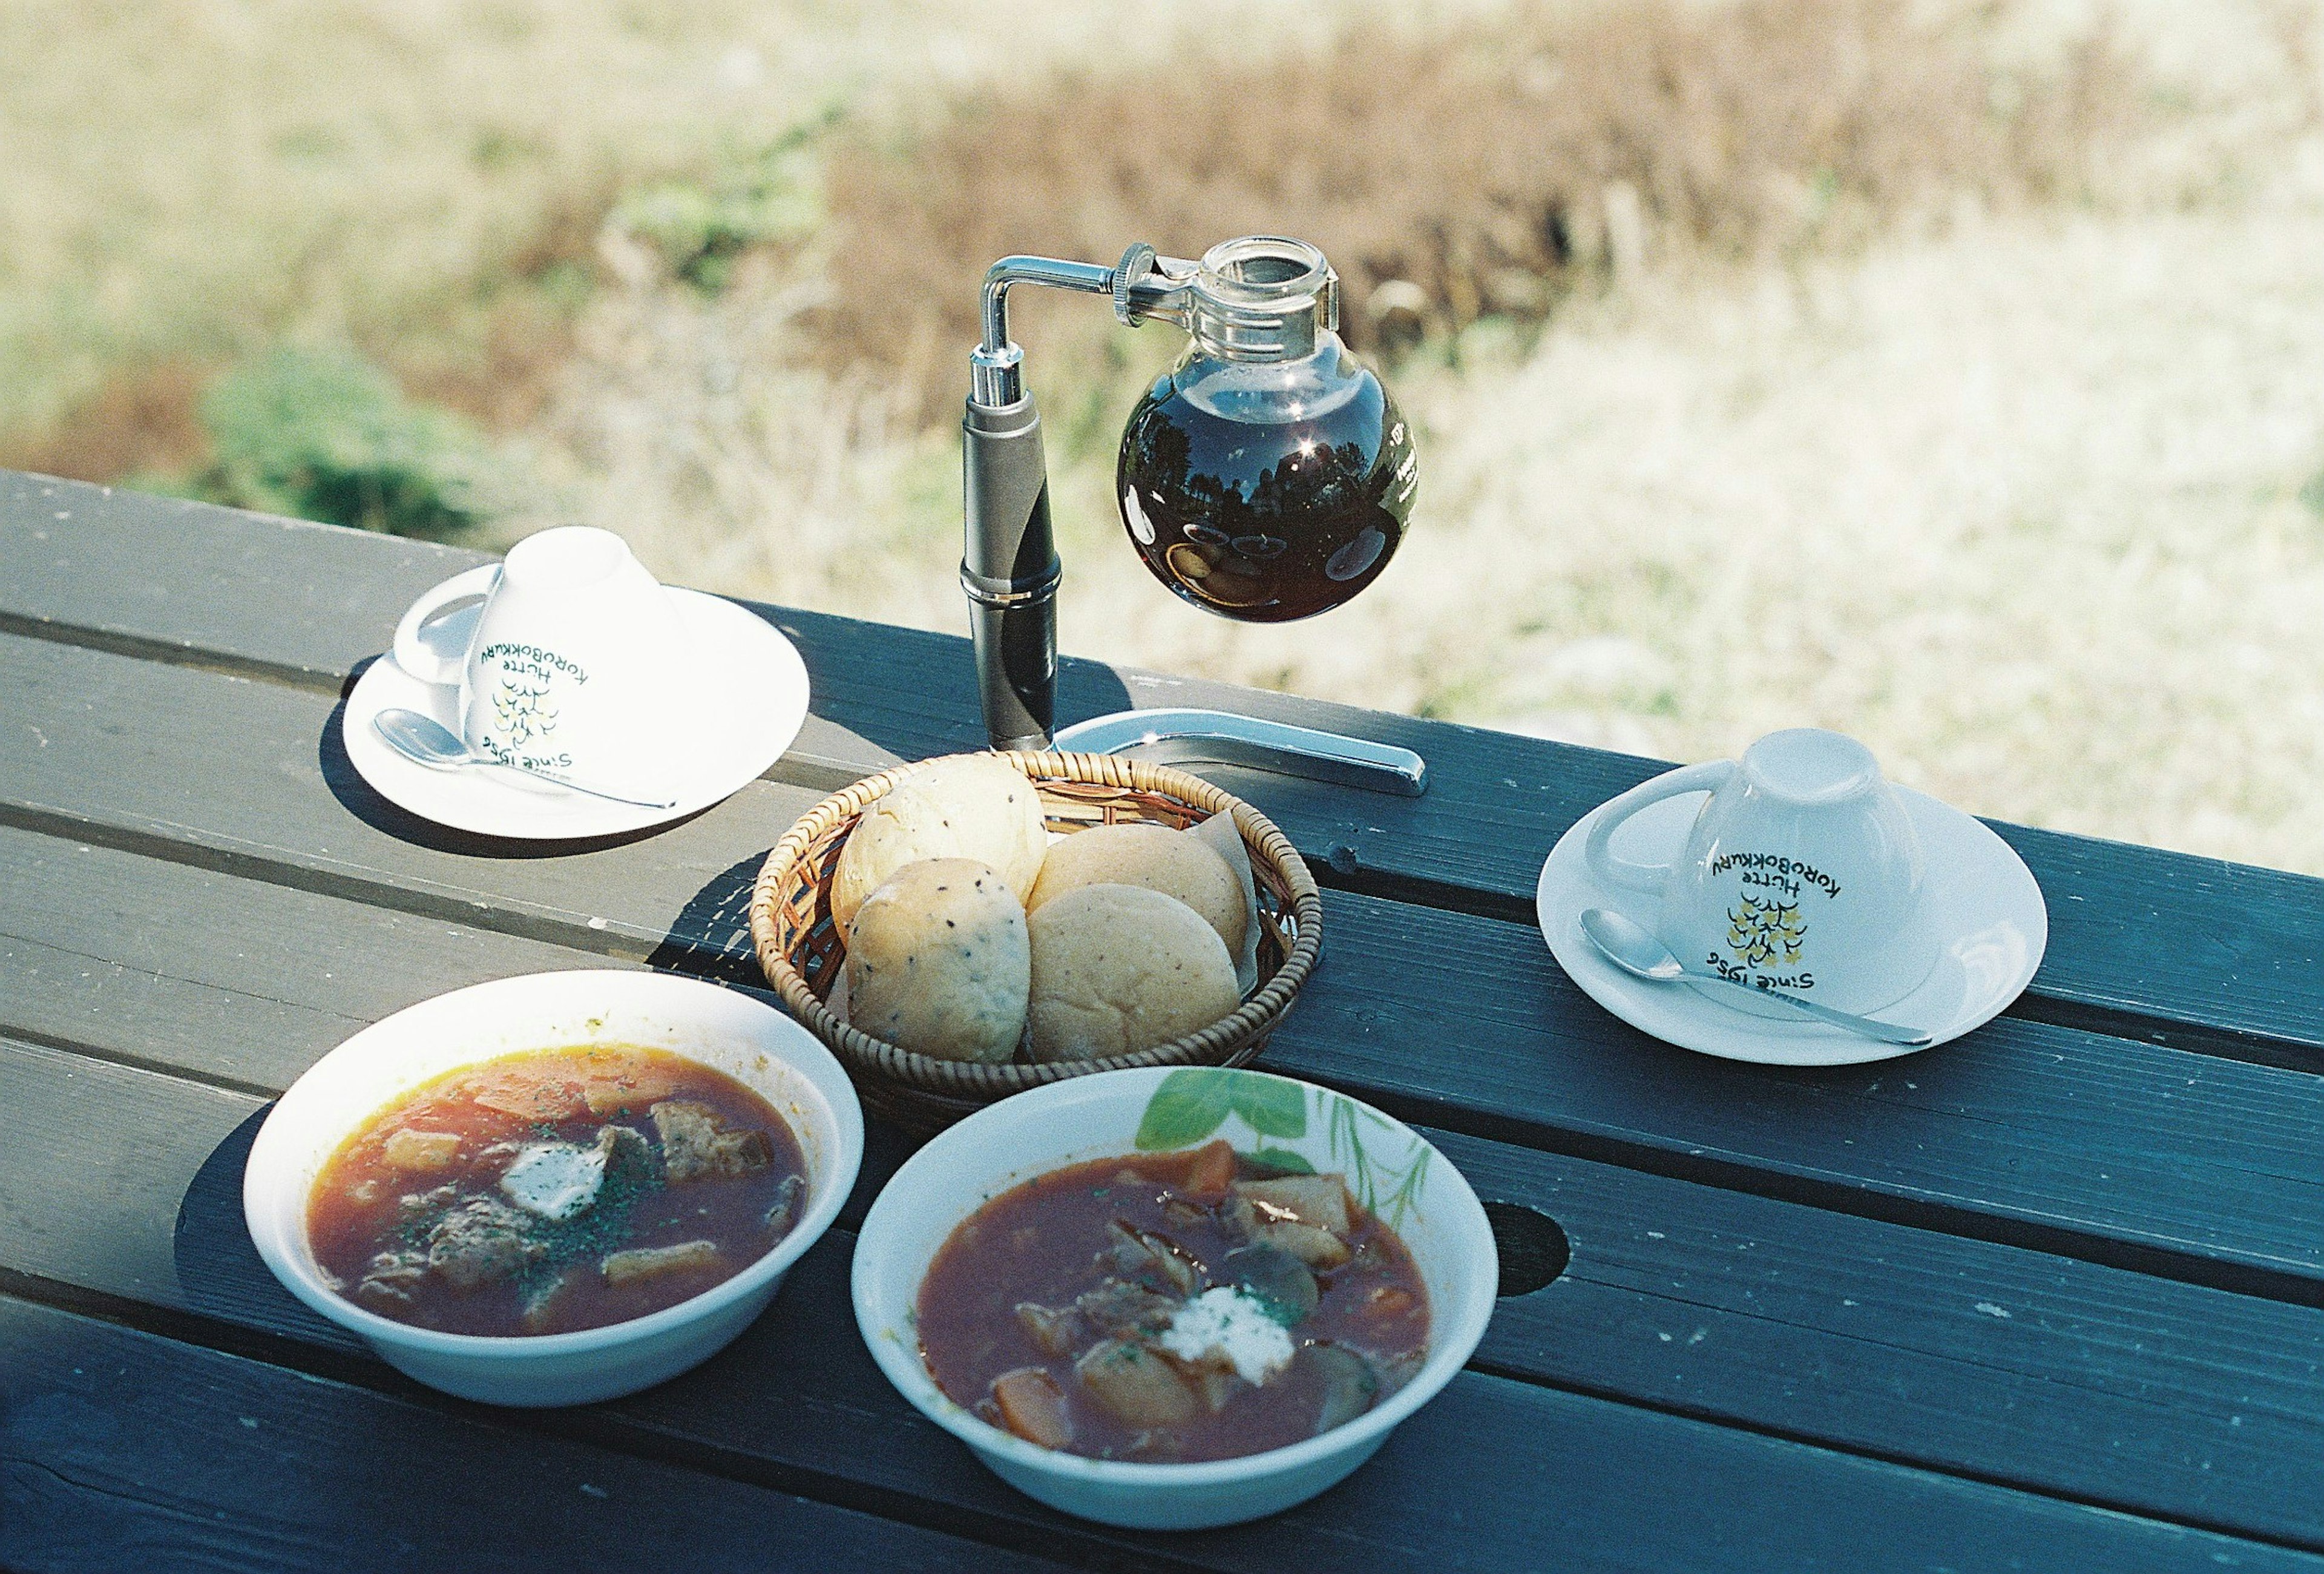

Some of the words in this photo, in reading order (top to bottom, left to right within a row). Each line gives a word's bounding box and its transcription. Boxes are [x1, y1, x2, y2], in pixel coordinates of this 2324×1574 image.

[522, 754, 572, 769] Since
[1706, 952, 1748, 984] 1956
[1757, 973, 1814, 989] Since
